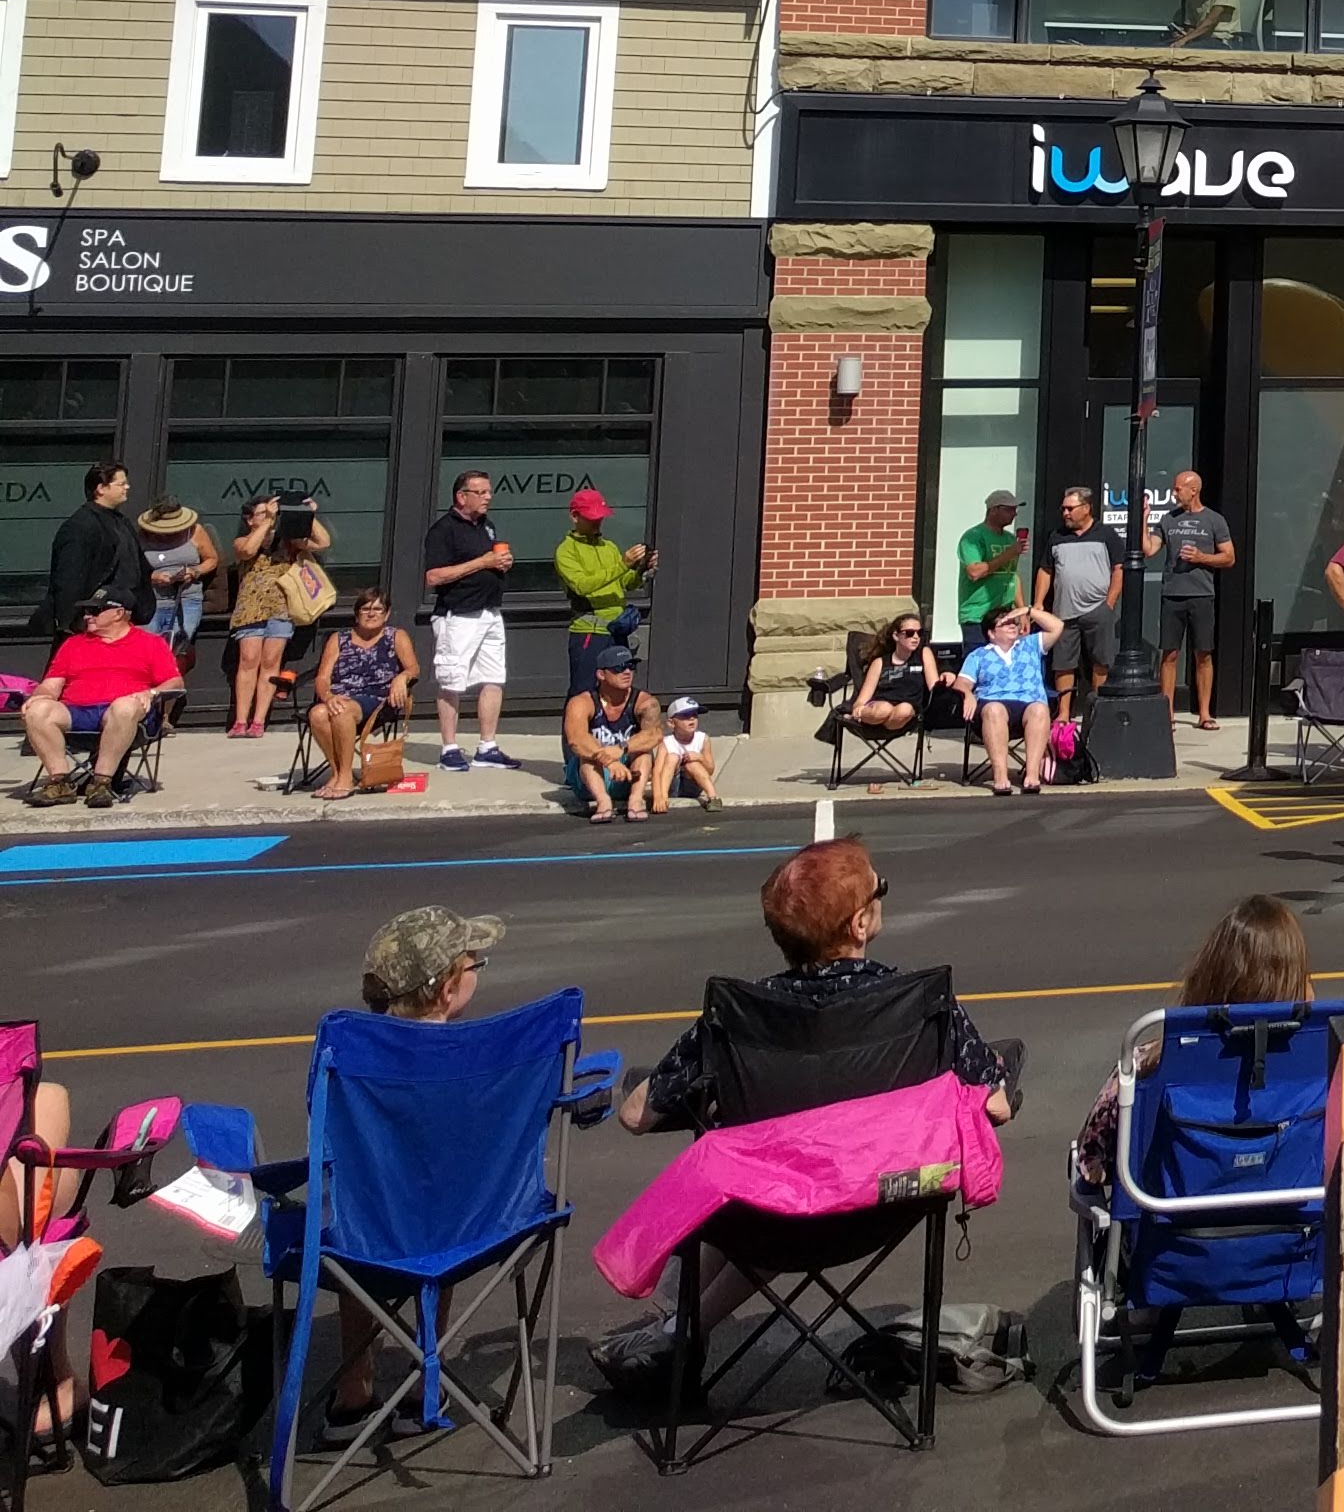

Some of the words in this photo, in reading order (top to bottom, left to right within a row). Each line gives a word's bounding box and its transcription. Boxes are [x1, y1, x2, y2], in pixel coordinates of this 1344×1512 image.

[81, 229, 126, 247] SPA
[79, 251, 161, 269] SALON
[75, 274, 195, 293] BOUTIQUE
[0, 482, 51, 502] DA
[494, 473, 597, 494] AVEDA
